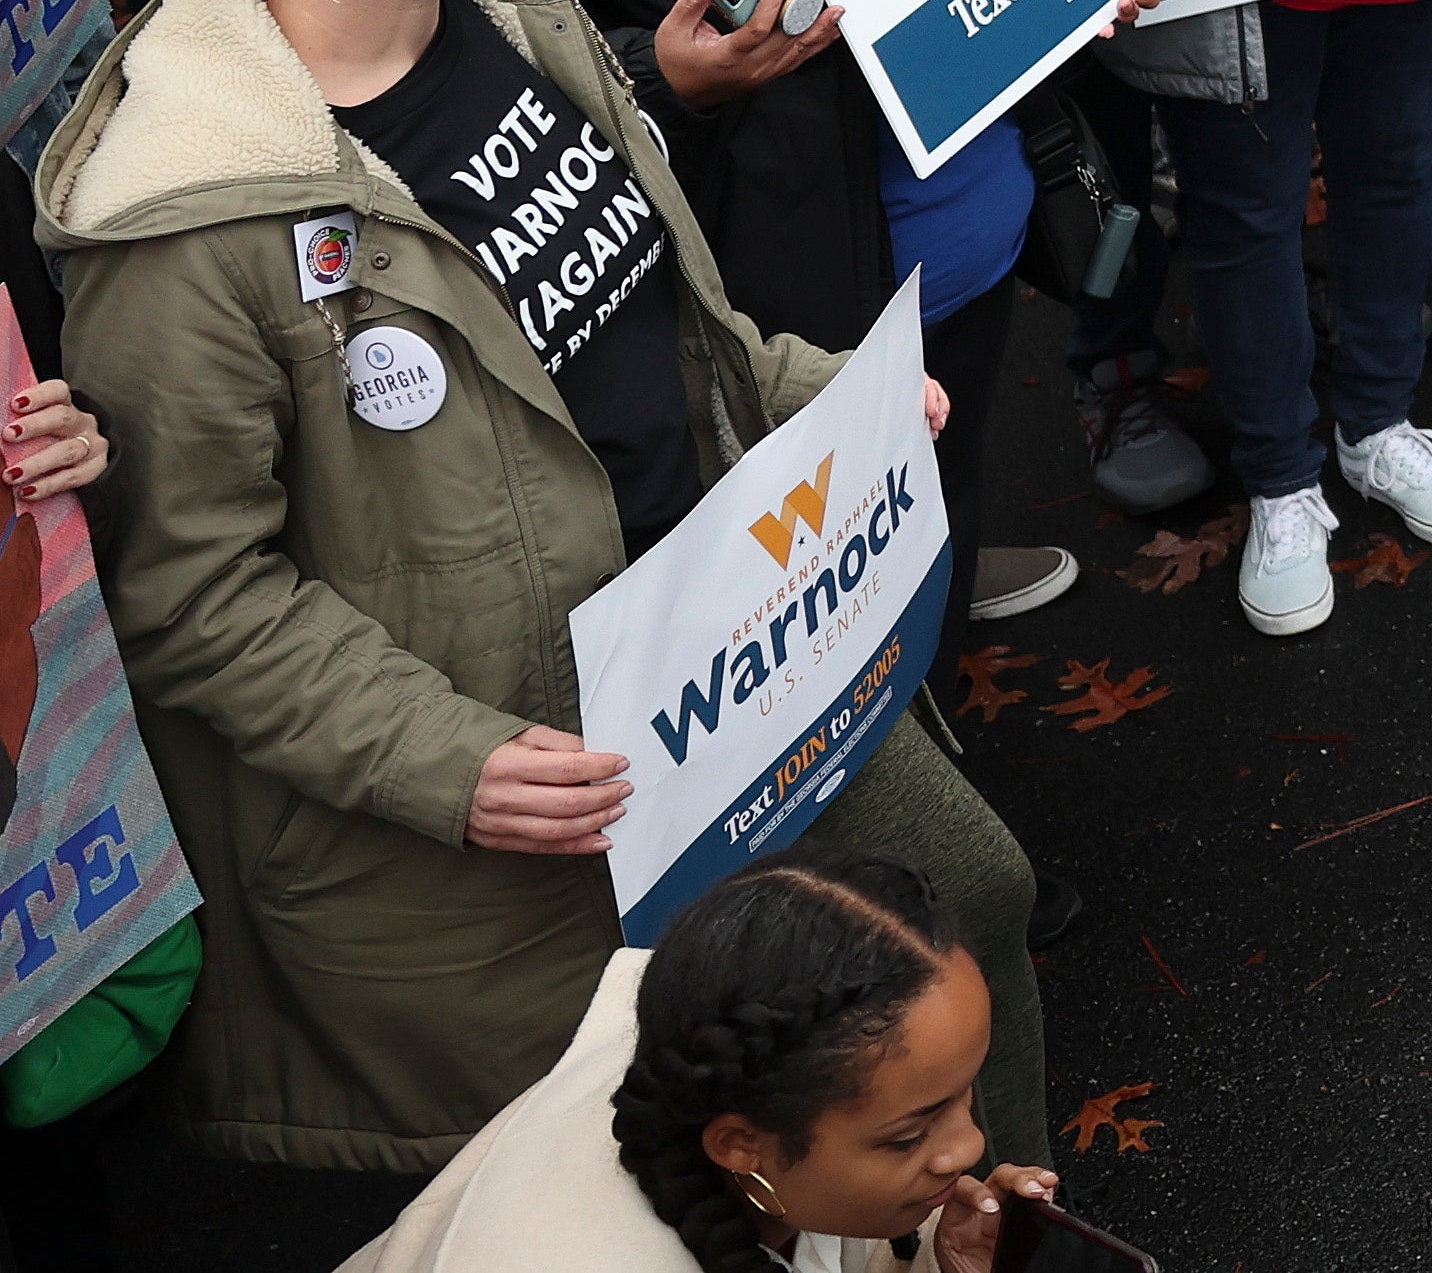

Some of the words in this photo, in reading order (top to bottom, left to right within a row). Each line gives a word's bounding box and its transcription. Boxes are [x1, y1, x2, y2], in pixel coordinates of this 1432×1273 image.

[450, 87, 557, 201] VOTE
[308, 228, 329, 276] PRO-CHOICE
[332, 245, 350, 281] PEACHES
[566, 320, 593, 359] BY
[353, 365, 431, 402] GEORGIA
[371, 388, 426, 414] VOTES
[731, 555, 820, 646] REVEREND
[826, 479, 884, 556] RAPHAEL
[650, 460, 916, 767] Warnock
[813, 570, 882, 665] SENATE
[723, 784, 774, 845] Text
[773, 727, 828, 801] JOIN
[830, 708, 850, 740] to
[853, 634, 901, 714] 52005
